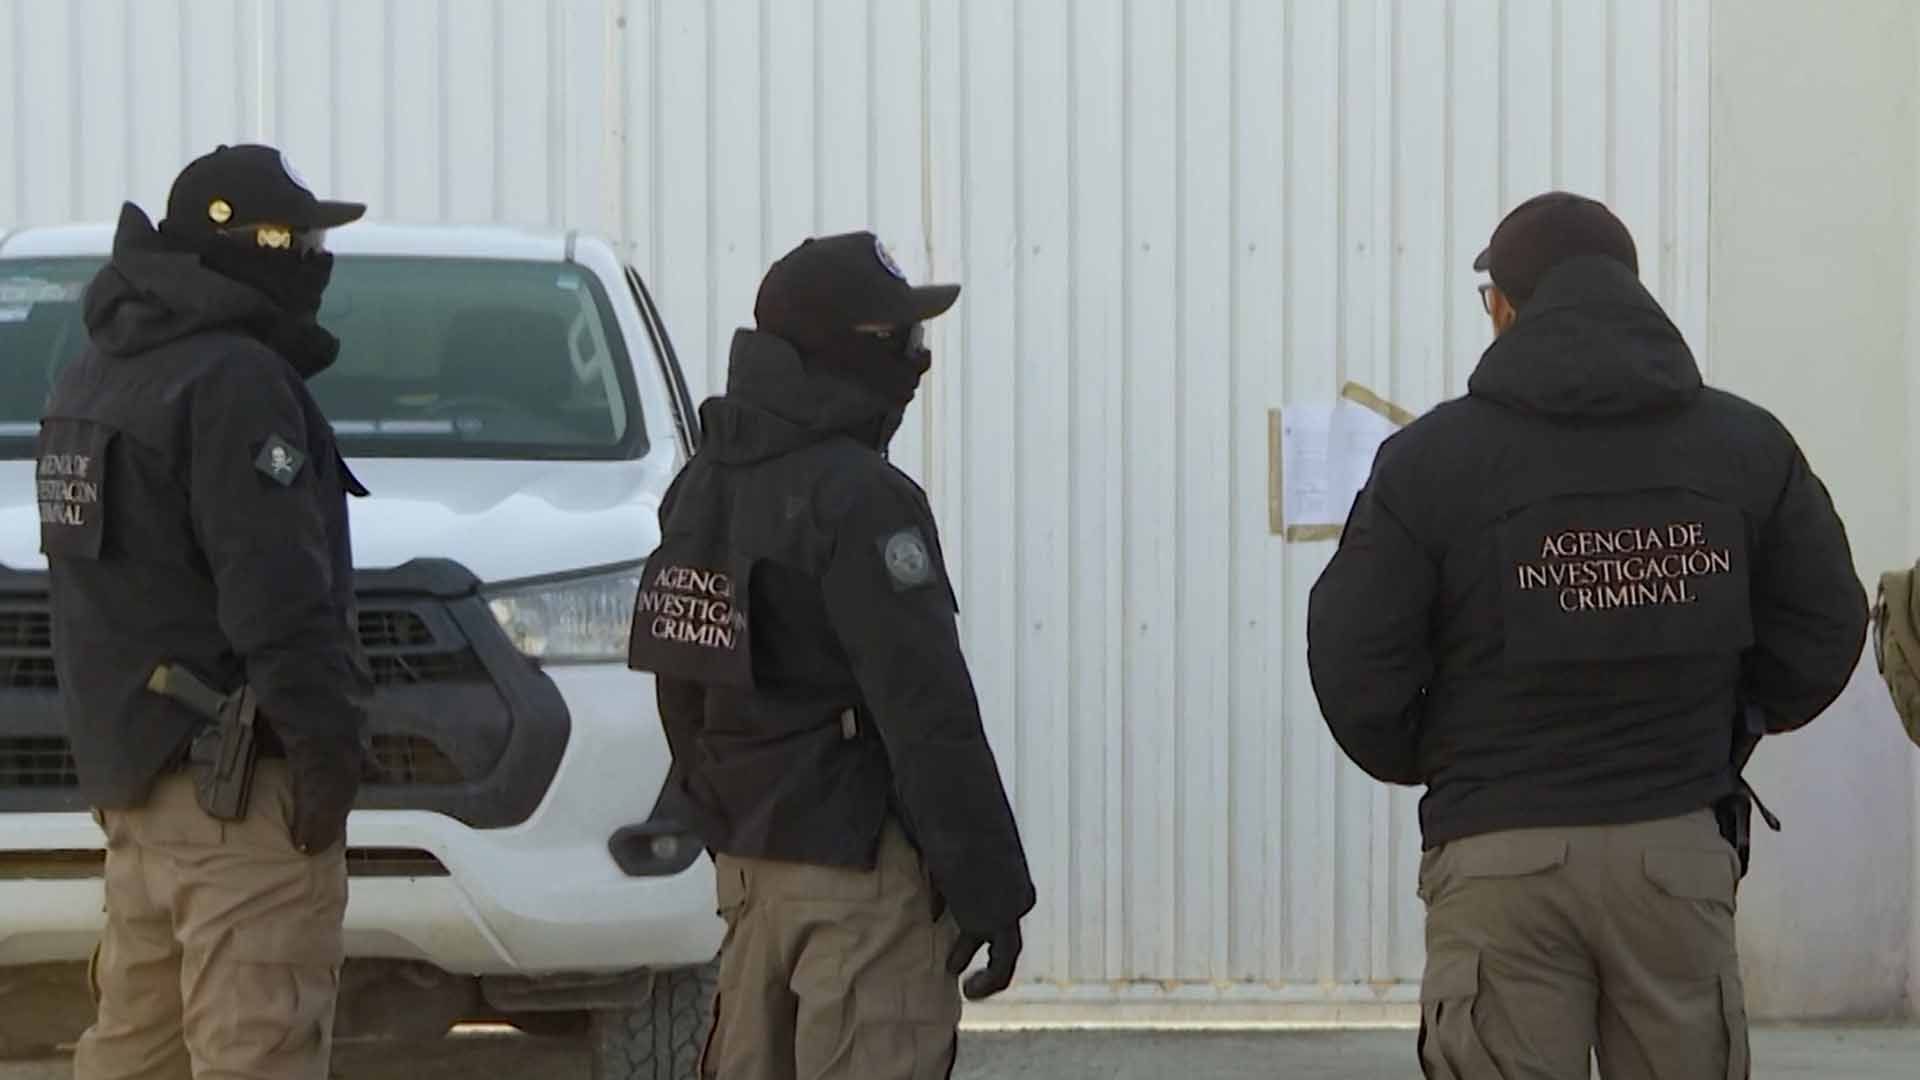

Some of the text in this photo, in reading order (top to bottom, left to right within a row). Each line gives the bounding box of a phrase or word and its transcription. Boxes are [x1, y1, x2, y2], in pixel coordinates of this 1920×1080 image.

[1541, 523, 1706, 558] AGENCIA DE
[654, 566, 733, 597] AGENC
[1518, 549, 1731, 589] INVESTIGACIÓN
[1560, 579, 1697, 611] CRIMINAL
[652, 613, 736, 649] CRIMIN
